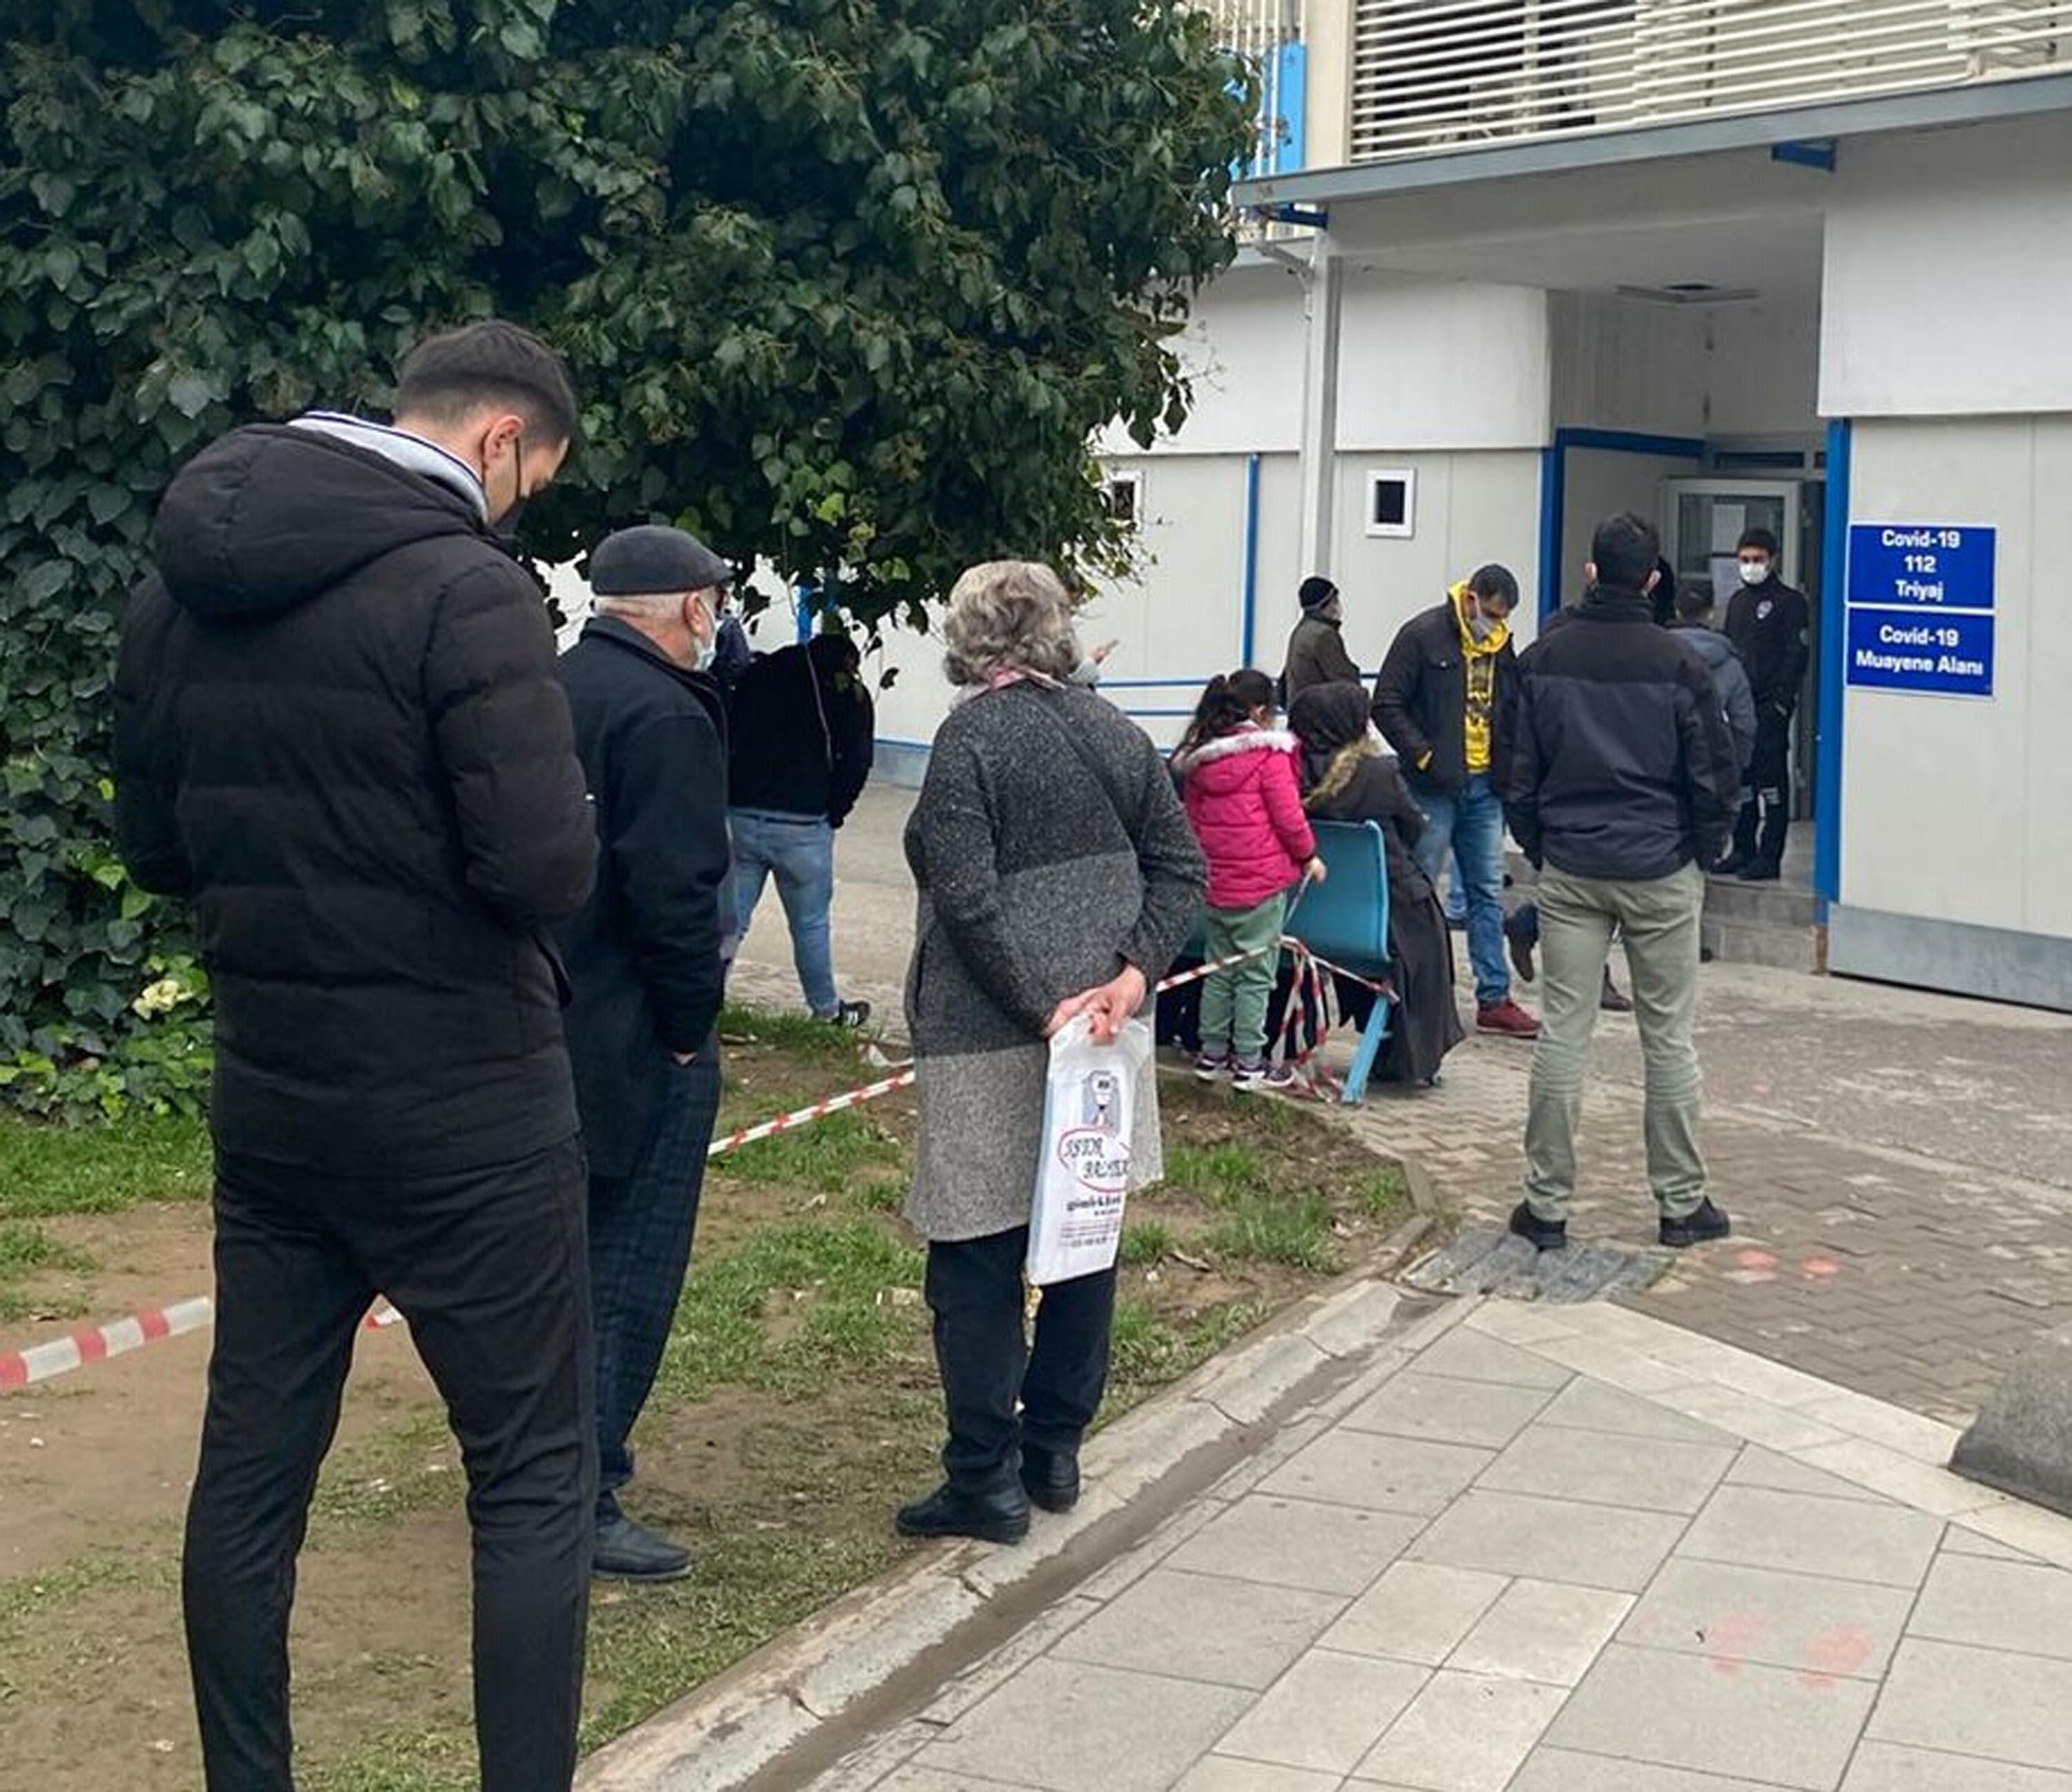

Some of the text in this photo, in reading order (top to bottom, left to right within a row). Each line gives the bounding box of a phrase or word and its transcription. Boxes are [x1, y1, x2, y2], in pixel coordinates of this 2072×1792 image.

[1882, 530, 1960, 549] Covid-19
[1903, 555, 1937, 573] 112
[1895, 580, 1944, 602] Triyaj
[1879, 625, 1959, 647] Covid-19
[1856, 650, 1983, 675] Muayene Alanı
